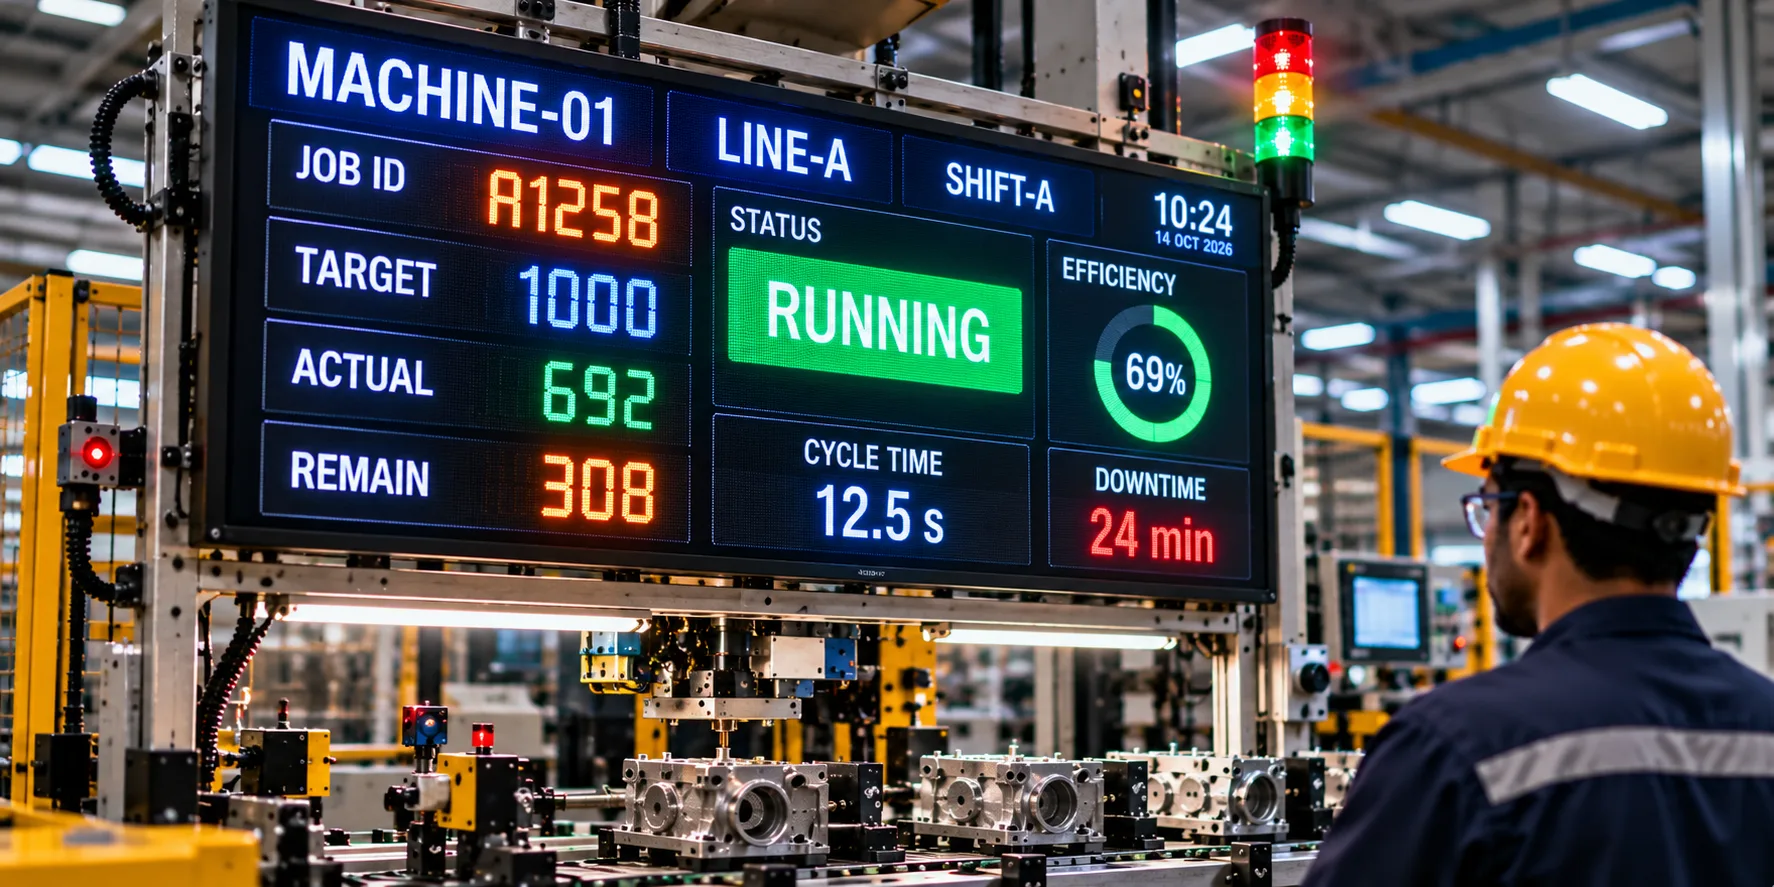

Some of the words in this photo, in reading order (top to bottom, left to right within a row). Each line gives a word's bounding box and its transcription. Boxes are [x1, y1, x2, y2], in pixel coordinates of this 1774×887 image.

[287, 41, 614, 146] MACHINE-01
[295, 145, 361, 186] JOB
[373, 155, 405, 192] ID
[718, 117, 852, 182] LINE-A
[488, 168, 659, 249] A1258
[945, 161, 1055, 213] SHIFT-A
[729, 205, 822, 243] STATUS
[1154, 191, 1233, 237] 10:24
[1155, 230, 1172, 247] 14
[1174, 233, 1201, 250] OCT
[1203, 238, 1234, 257] 2026
[295, 245, 437, 298] TARGET
[1062, 256, 1177, 296] EFFICIENCY
[519, 265, 657, 339] 1000
[768, 280, 990, 363] RUNNING
[291, 348, 434, 397] ACTUAL
[543, 361, 655, 430] 692
[1125, 352, 1186, 396] 69%
[291, 450, 429, 497] REMAIN
[804, 438, 879, 471] CYCLE
[886, 446, 943, 477] TIME
[1095, 466, 1206, 501] DOWNTIME
[542, 454, 656, 525] 308
[816, 484, 911, 542] 12.5
[923, 508, 944, 544] s
[1088, 505, 1140, 559] 24
[1149, 515, 1216, 564] min
